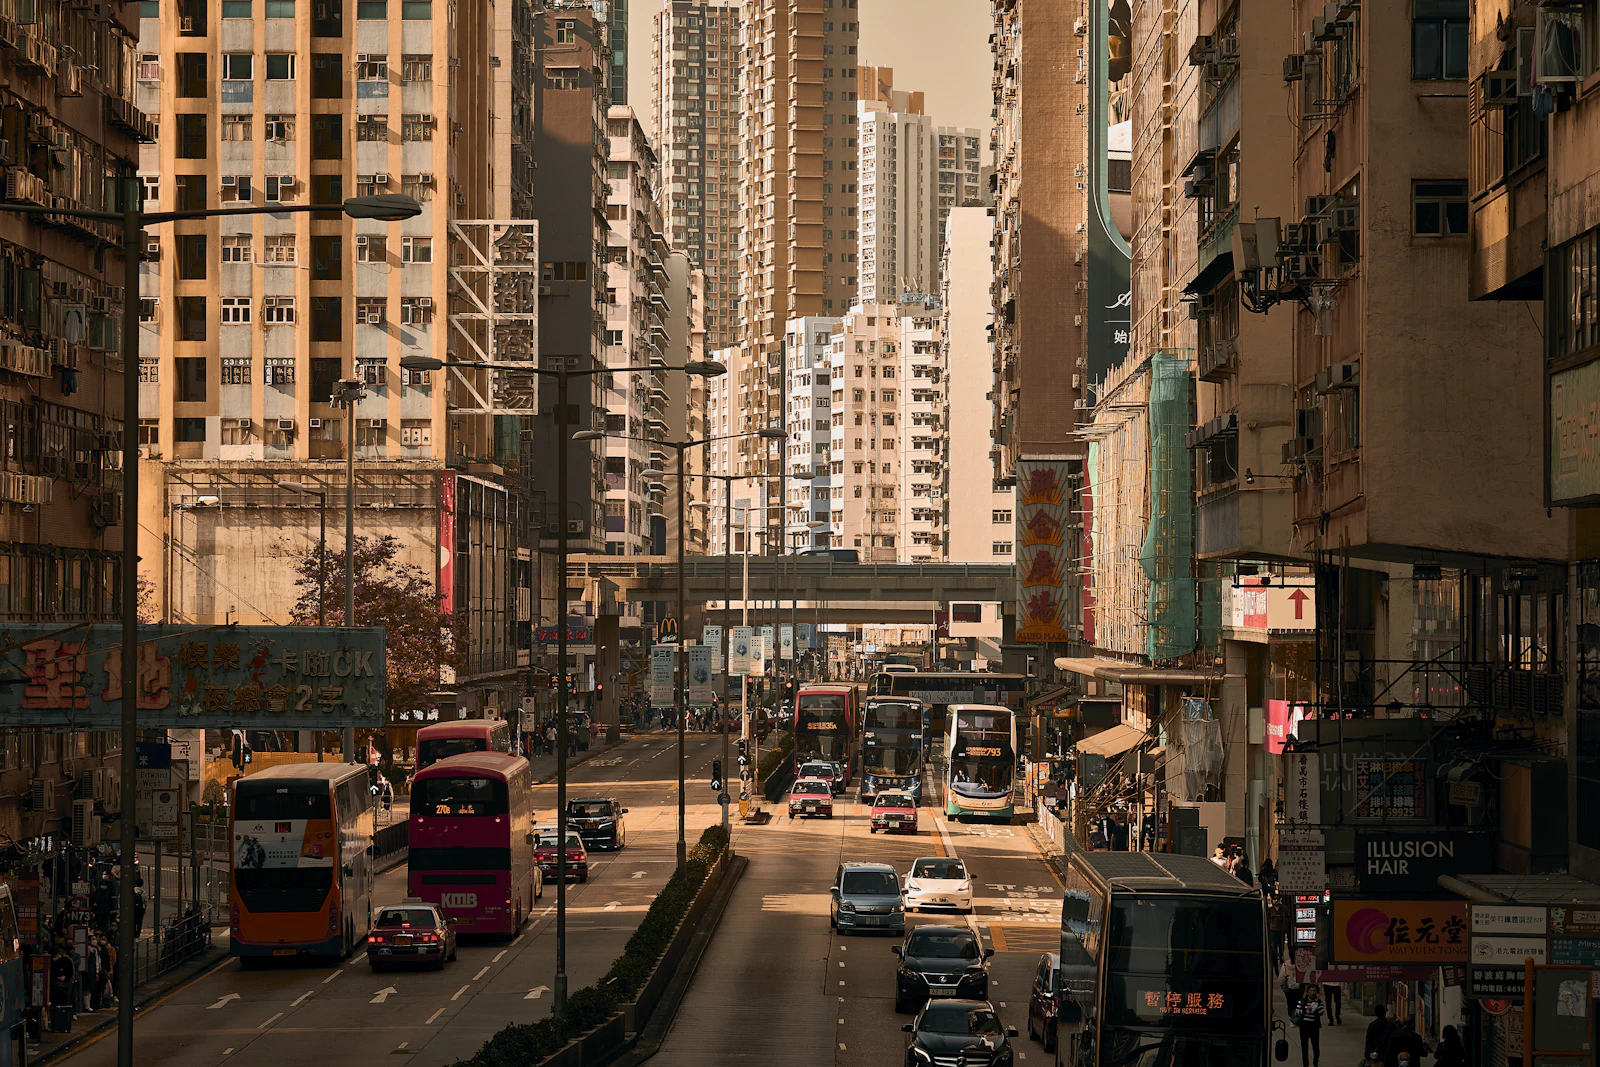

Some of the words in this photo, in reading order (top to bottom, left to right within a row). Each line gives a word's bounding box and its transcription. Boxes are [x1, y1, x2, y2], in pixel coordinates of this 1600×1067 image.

[494, 223, 533, 408] 金都商場
[1113, 329, 1131, 344] 始
[1581, 401, 1600, 464] 太子
[1018, 632, 1042, 640] ALLIED
[1044, 632, 1067, 640] PLAZA
[180, 641, 241, 671] 娛樂
[272, 648, 375, 678] 卡啦OK
[20, 639, 173, 710] 聖地
[987, 747, 1001, 757] 793
[1367, 840, 1454, 858] ILLUSION
[1367, 860, 1409, 876] HAIR
[441, 893, 478, 908] KMB
[71, 911, 91, 921] N73
[1384, 915, 1467, 945] 位元堂
[1389, 946, 1407, 954] WAI
[1410, 946, 1435, 954] YUEN
[1438, 946, 1467, 954] TONG
[1473, 970, 1535, 981] 碧波庭胸部
[1144, 990, 1225, 1009] 暫停服務
